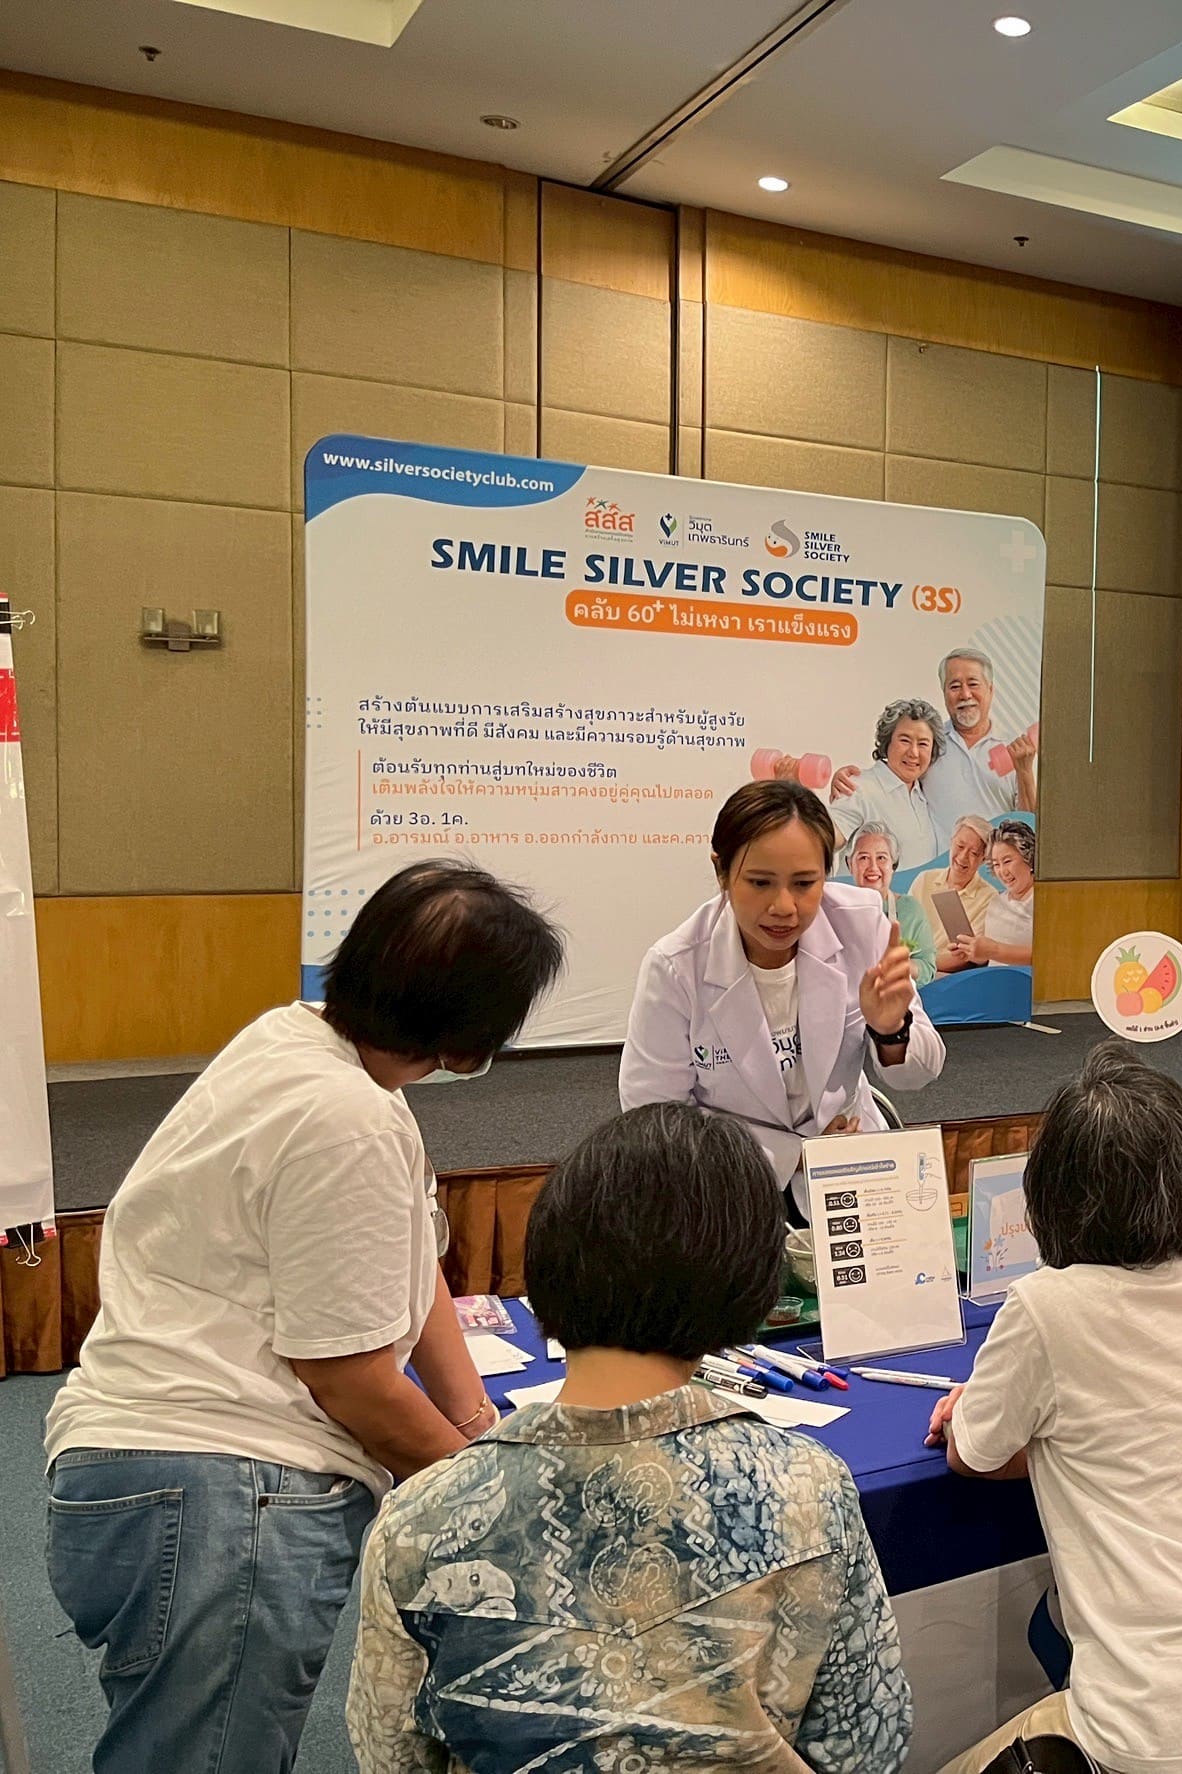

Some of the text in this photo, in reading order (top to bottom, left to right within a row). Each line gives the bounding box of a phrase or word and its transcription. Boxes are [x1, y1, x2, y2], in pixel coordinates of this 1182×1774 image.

[323, 452, 554, 492] www.silversocietyclub.com
[585, 510, 635, 531] สสส
[688, 520, 712, 534] วิมุต
[688, 532, 750, 548] เทพธารินทร์
[804, 531, 836, 542] SMILE
[804, 541, 841, 553] SILVER
[804, 551, 850, 563] SOCIETY
[431, 538, 962, 614] SMILE SILVER SOCIETY (3S)
[573, 595, 620, 622] คลับ
[668, 602, 742, 630] ไม่เหงา
[747, 611, 852, 639] เราแข็งแรง
[358, 696, 746, 732] สร้างต้นแบบการเสริมสร้างสุขภาวะสำหรับผู้สูงวัย
[358, 717, 746, 750] ให้มีสุขภาพที่ดี มีสังคม และมีความรอบรู้ด้านสุขภาพ
[371, 759, 618, 782] ต้อนรับทุกท่านสู่บทใหม่ของชีวิต
[371, 778, 714, 803] เติมพลังใจให้ความหนุ่มสาวคงอยู่คู่คุณไปตลอด
[370, 808, 469, 826] ด้วย 3อ. 1ค.
[372, 828, 710, 844] อ.อารมณ์ อ.อาหาร อ.ออกกำลังกาย และค.ควา
